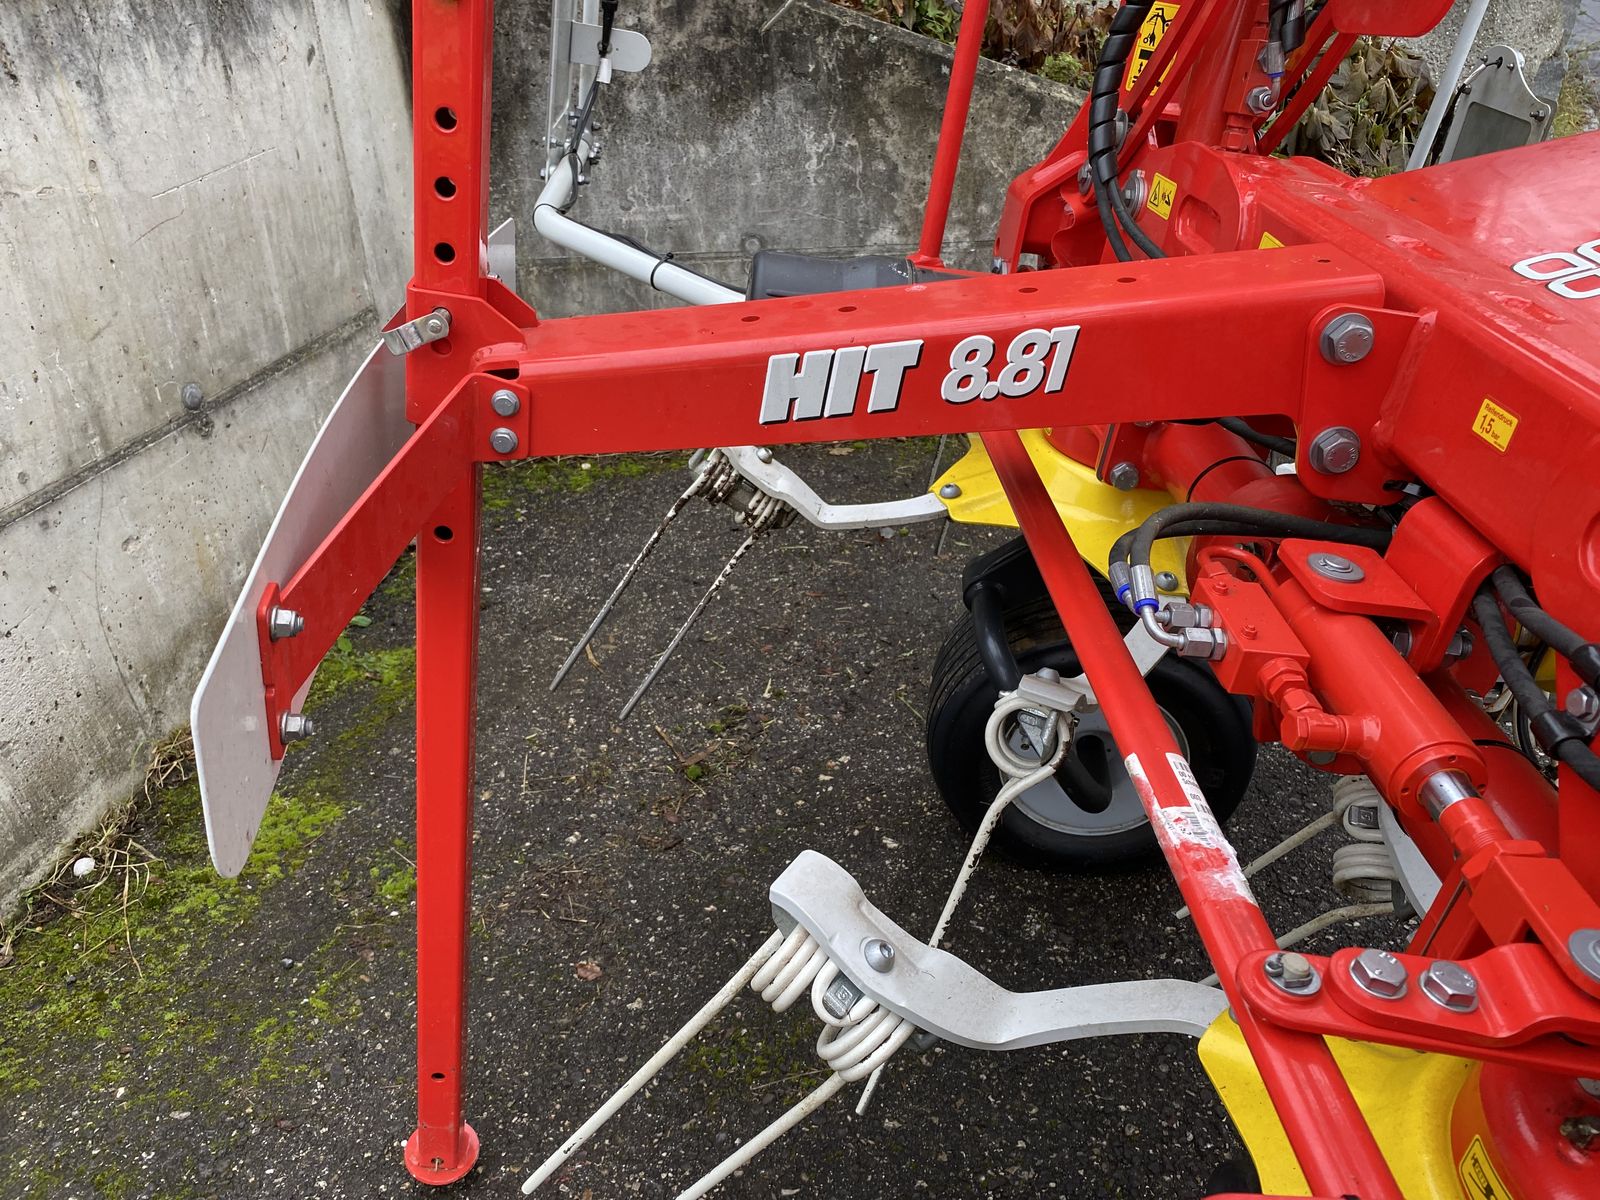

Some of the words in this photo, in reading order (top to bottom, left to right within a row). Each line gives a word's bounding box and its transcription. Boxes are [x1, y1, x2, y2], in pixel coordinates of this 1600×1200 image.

[759, 340, 924, 424] HIT
[940, 325, 1081, 403] 8.81
[1480, 414, 1495, 434] 1,5
